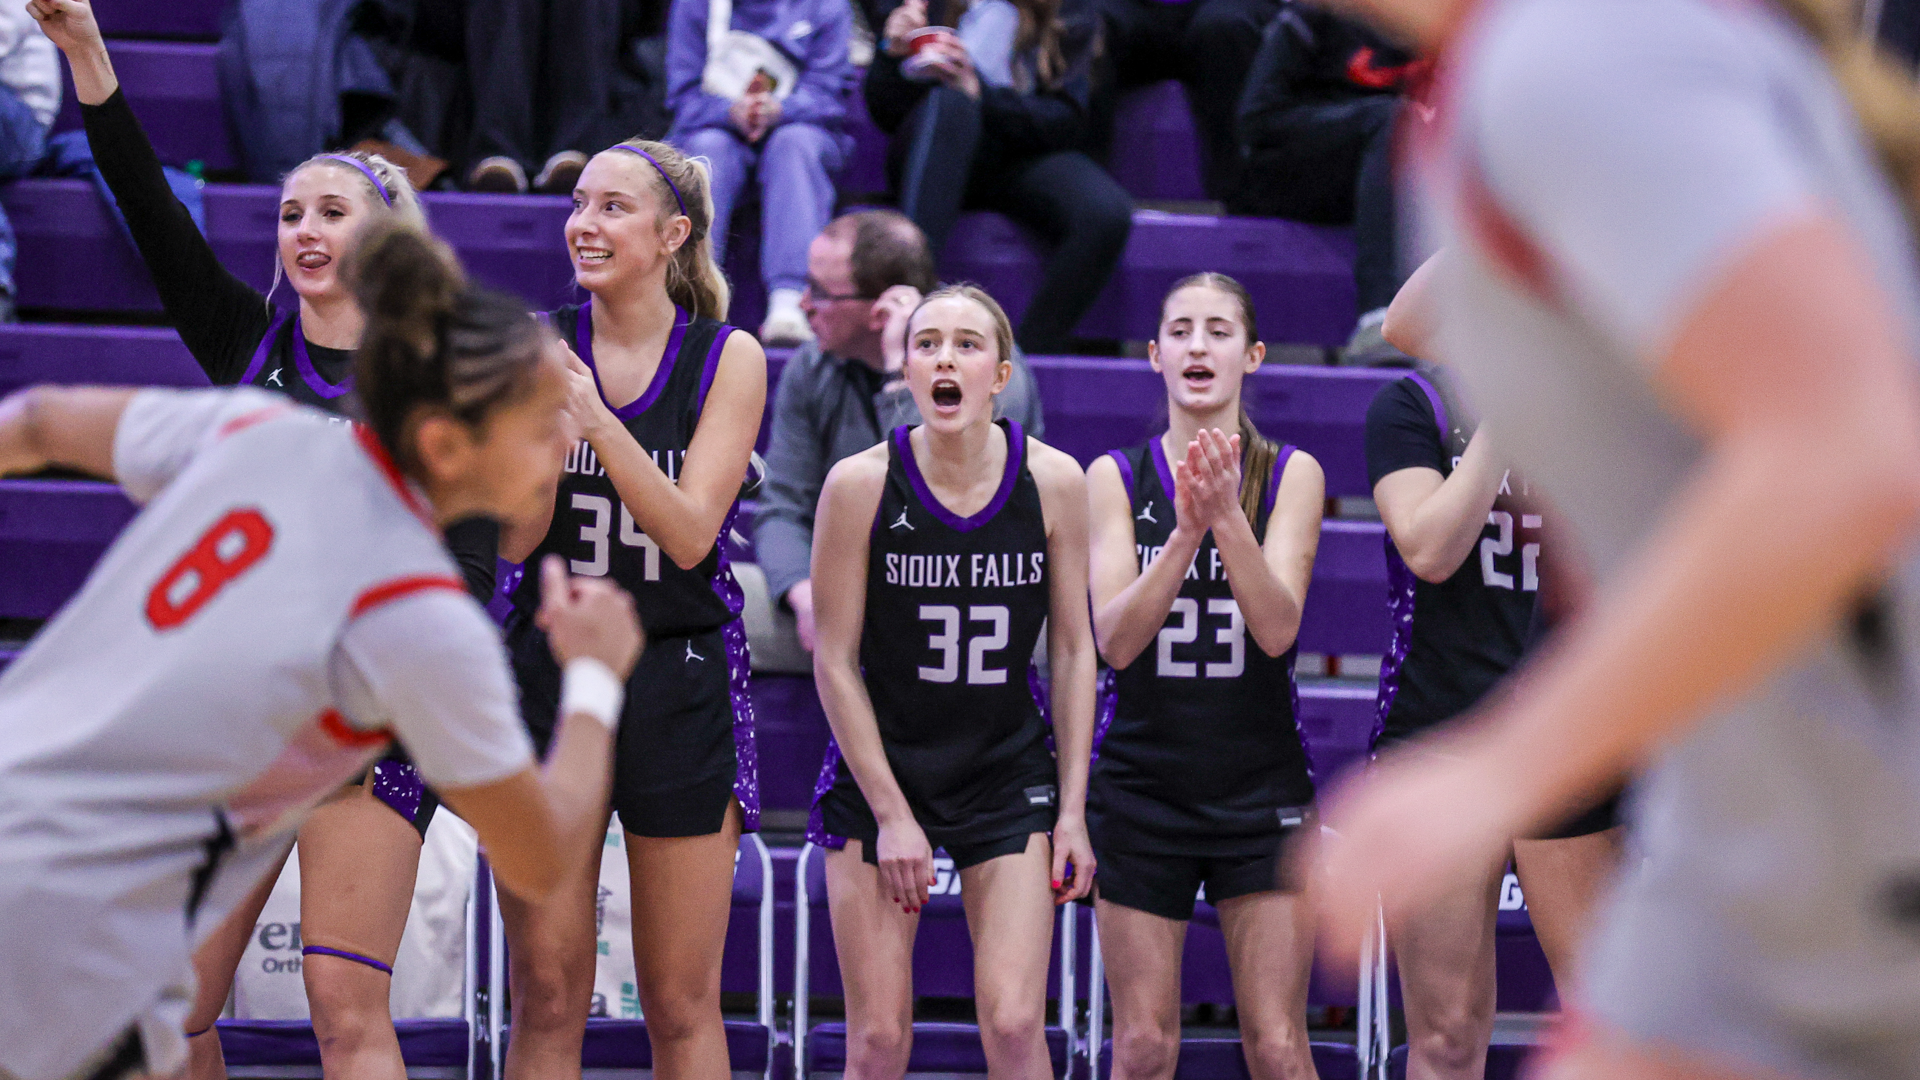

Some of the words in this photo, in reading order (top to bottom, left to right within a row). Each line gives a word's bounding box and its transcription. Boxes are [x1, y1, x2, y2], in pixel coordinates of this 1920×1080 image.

[145, 510, 274, 634] 8
[570, 493, 661, 582] 34
[885, 552, 961, 588] SIOUX
[970, 552, 1044, 588] FALLS
[918, 604, 1010, 685] 32
[1156, 597, 1246, 678] 23
